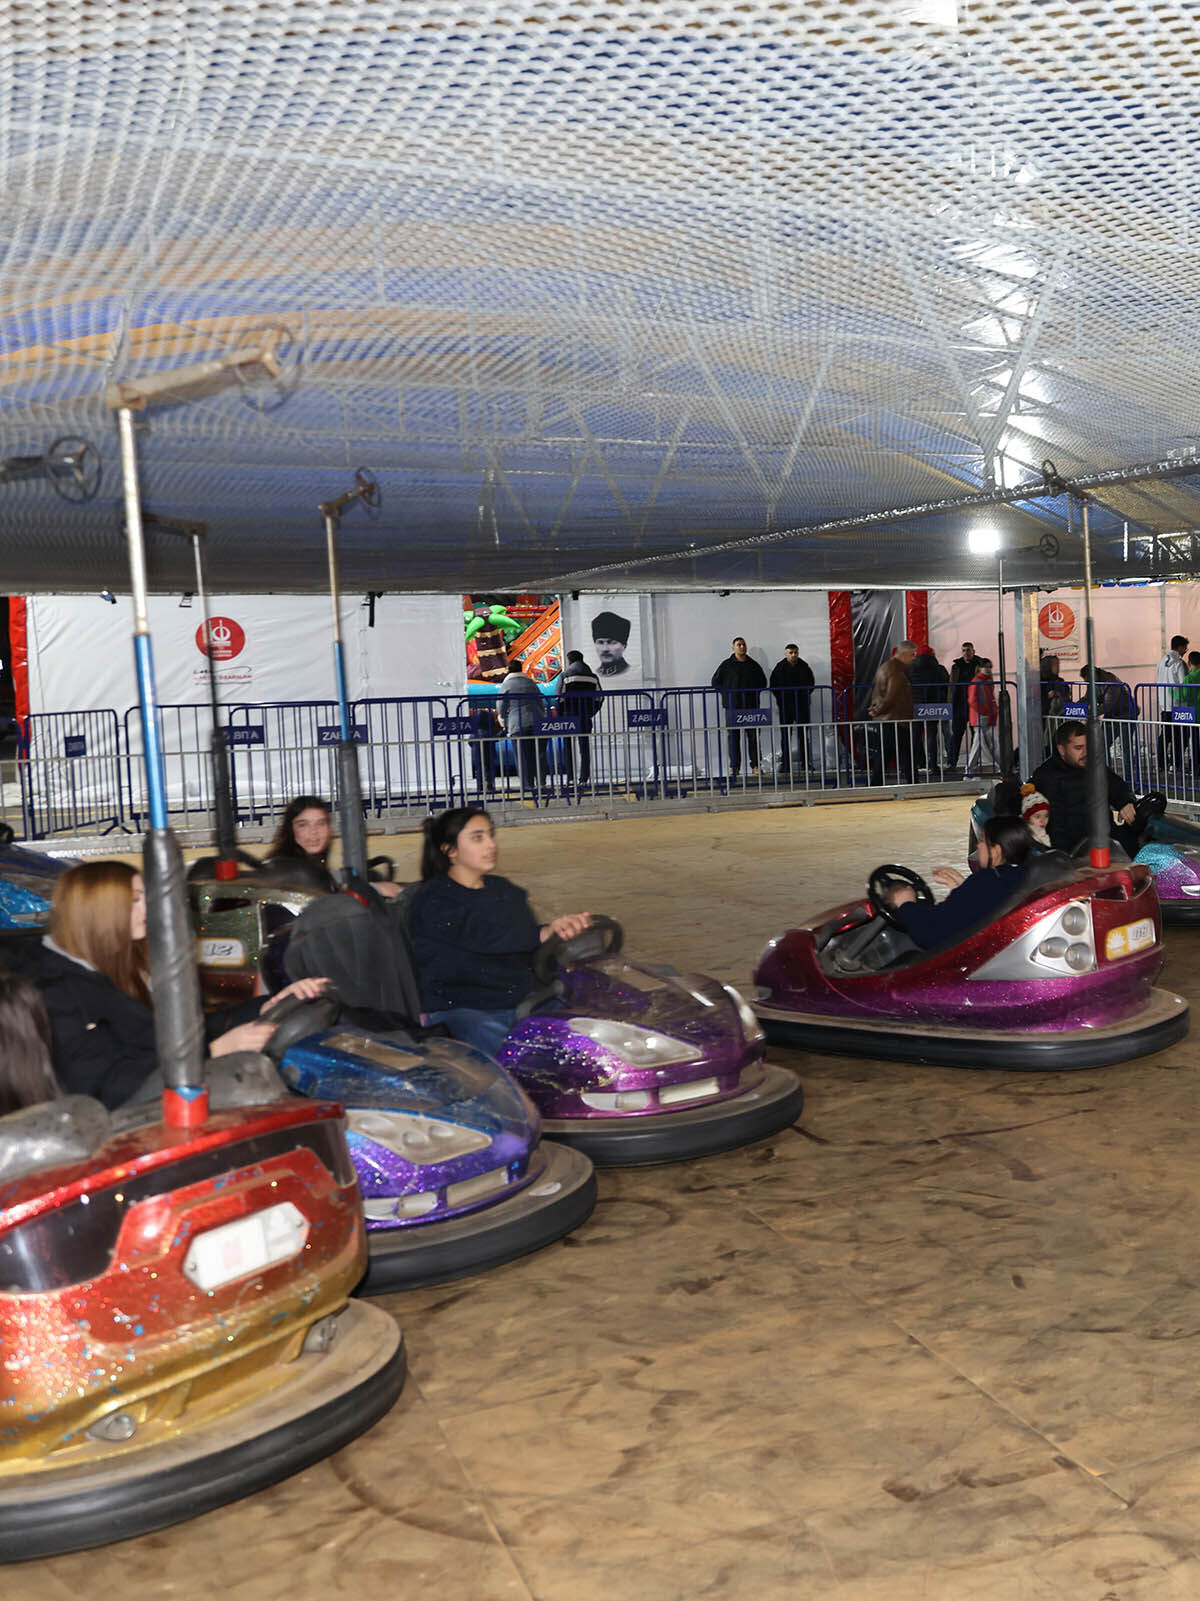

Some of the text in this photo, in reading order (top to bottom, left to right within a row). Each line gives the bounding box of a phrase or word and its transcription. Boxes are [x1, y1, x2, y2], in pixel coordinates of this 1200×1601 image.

[918, 707, 949, 716] ZABITA
[1065, 707, 1086, 716] ZABITA
[736, 713, 767, 723] ZABITA
[1174, 712, 1193, 721] ZABITA
[541, 722, 576, 731] ZABITA
